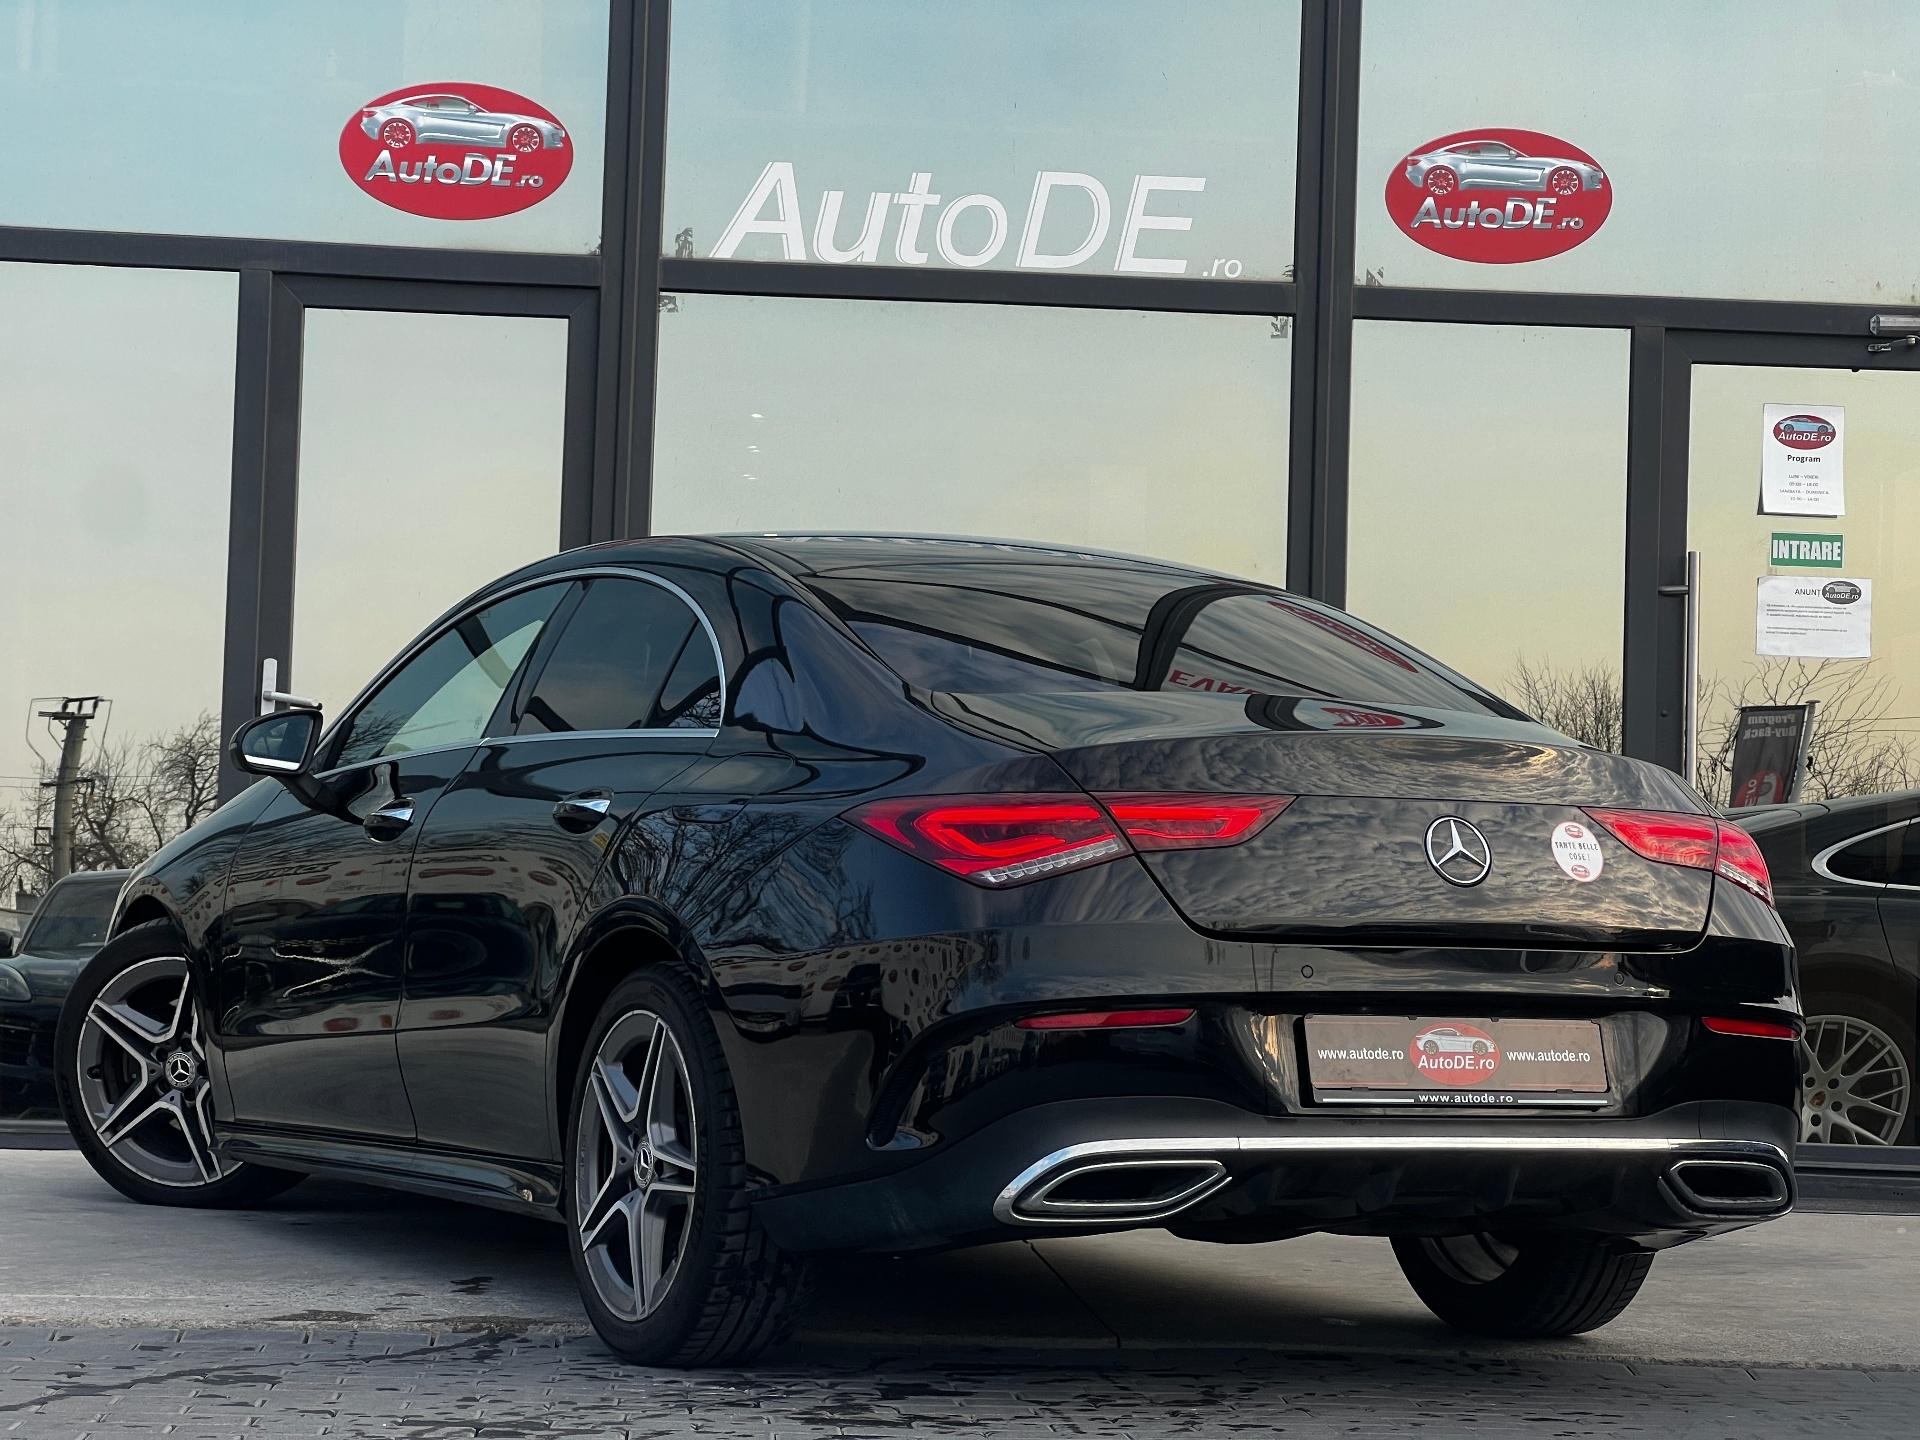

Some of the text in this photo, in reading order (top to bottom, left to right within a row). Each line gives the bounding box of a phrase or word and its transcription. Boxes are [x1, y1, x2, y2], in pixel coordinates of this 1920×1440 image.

[1777, 431, 1832, 442] AutoDE.ro
[1787, 454, 1821, 463] Program
[1772, 539, 1841, 561] INTRARE
[1554, 841, 1599, 851] TANTE BELLE
[1317, 1048, 1404, 1060] www.autode.ro
[1506, 1049, 1591, 1062] www.autode.ro
[1417, 1055, 1495, 1071] AutoDE.ro
[1418, 1093, 1513, 1104] www.autode.ro
